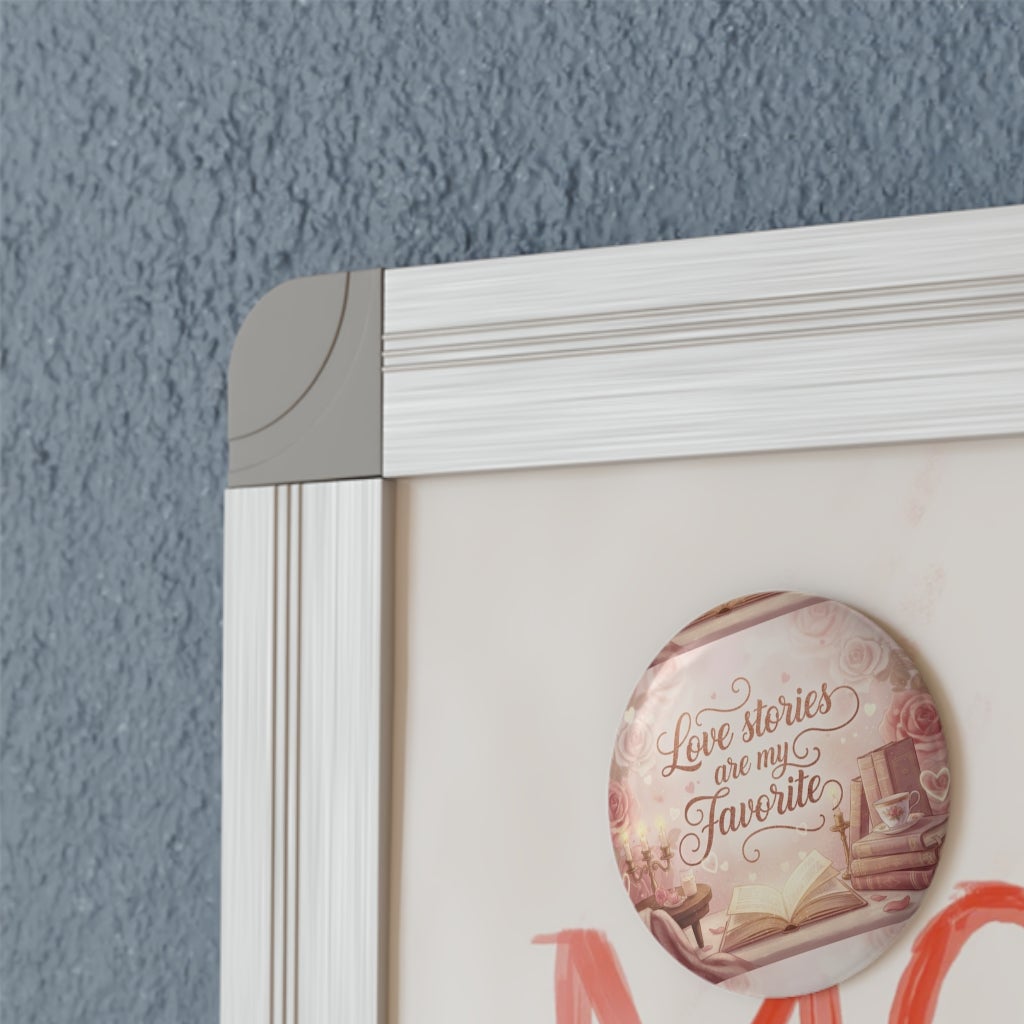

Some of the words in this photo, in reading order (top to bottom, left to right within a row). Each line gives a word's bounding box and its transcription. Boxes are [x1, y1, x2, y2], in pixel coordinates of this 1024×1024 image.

[656, 711, 735, 778] Love
[742, 682, 859, 745] stories
[714, 753, 753, 786] are
[756, 741, 810, 780] my
[679, 770, 843, 866] Favorite
